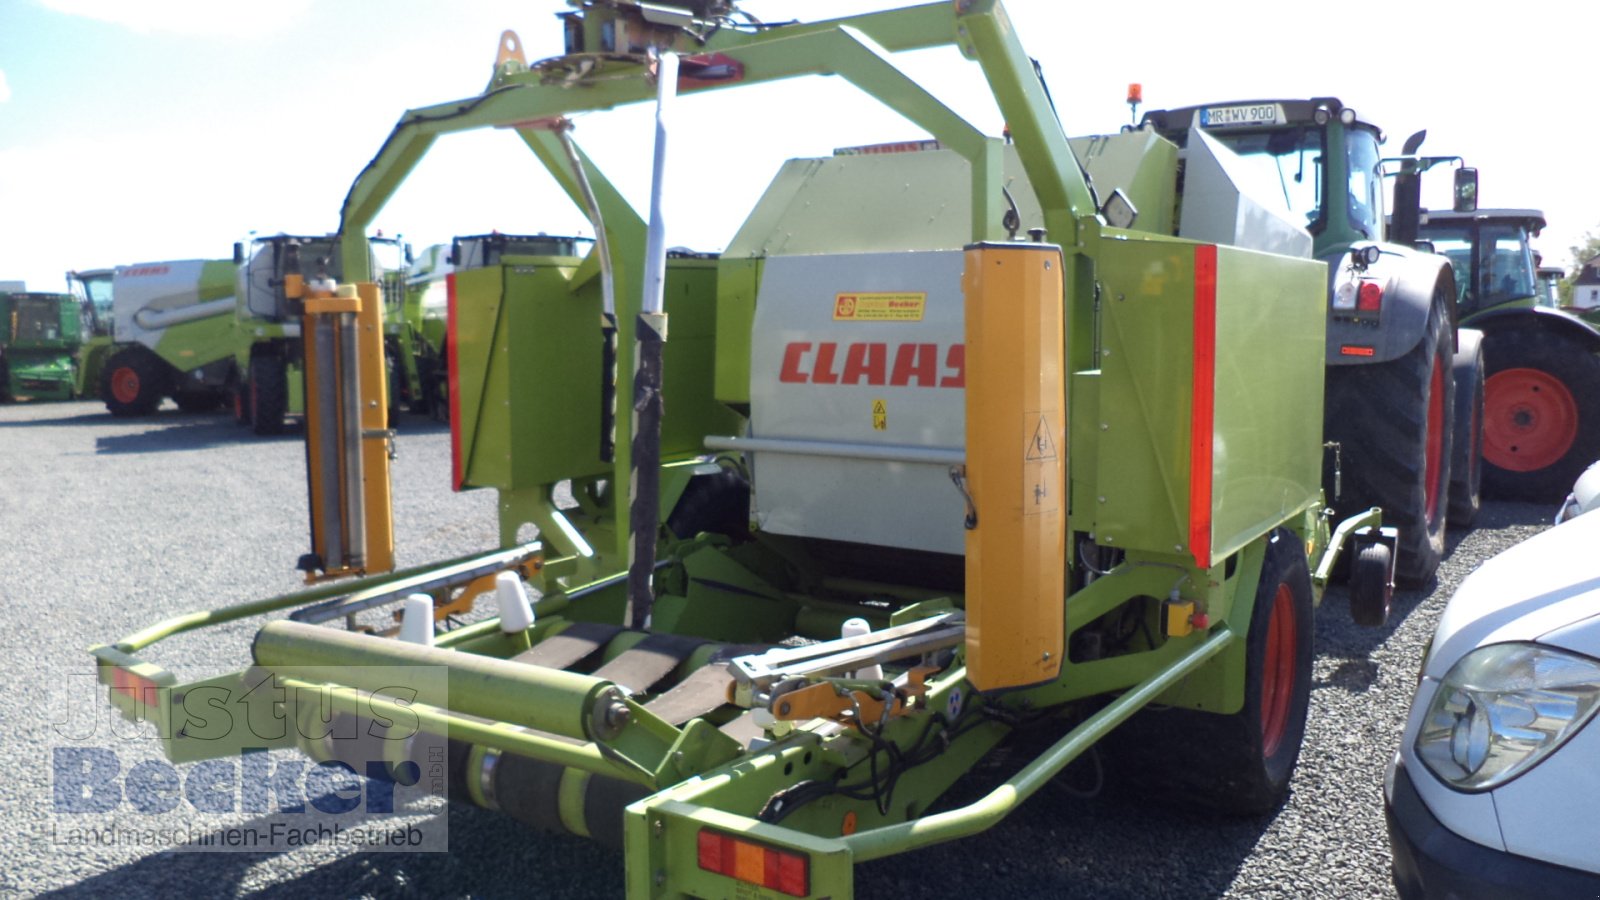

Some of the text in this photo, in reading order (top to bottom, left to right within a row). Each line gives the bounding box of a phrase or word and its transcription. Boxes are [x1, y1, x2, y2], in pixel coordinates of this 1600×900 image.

[1208, 106, 1274, 123] MR WV 900
